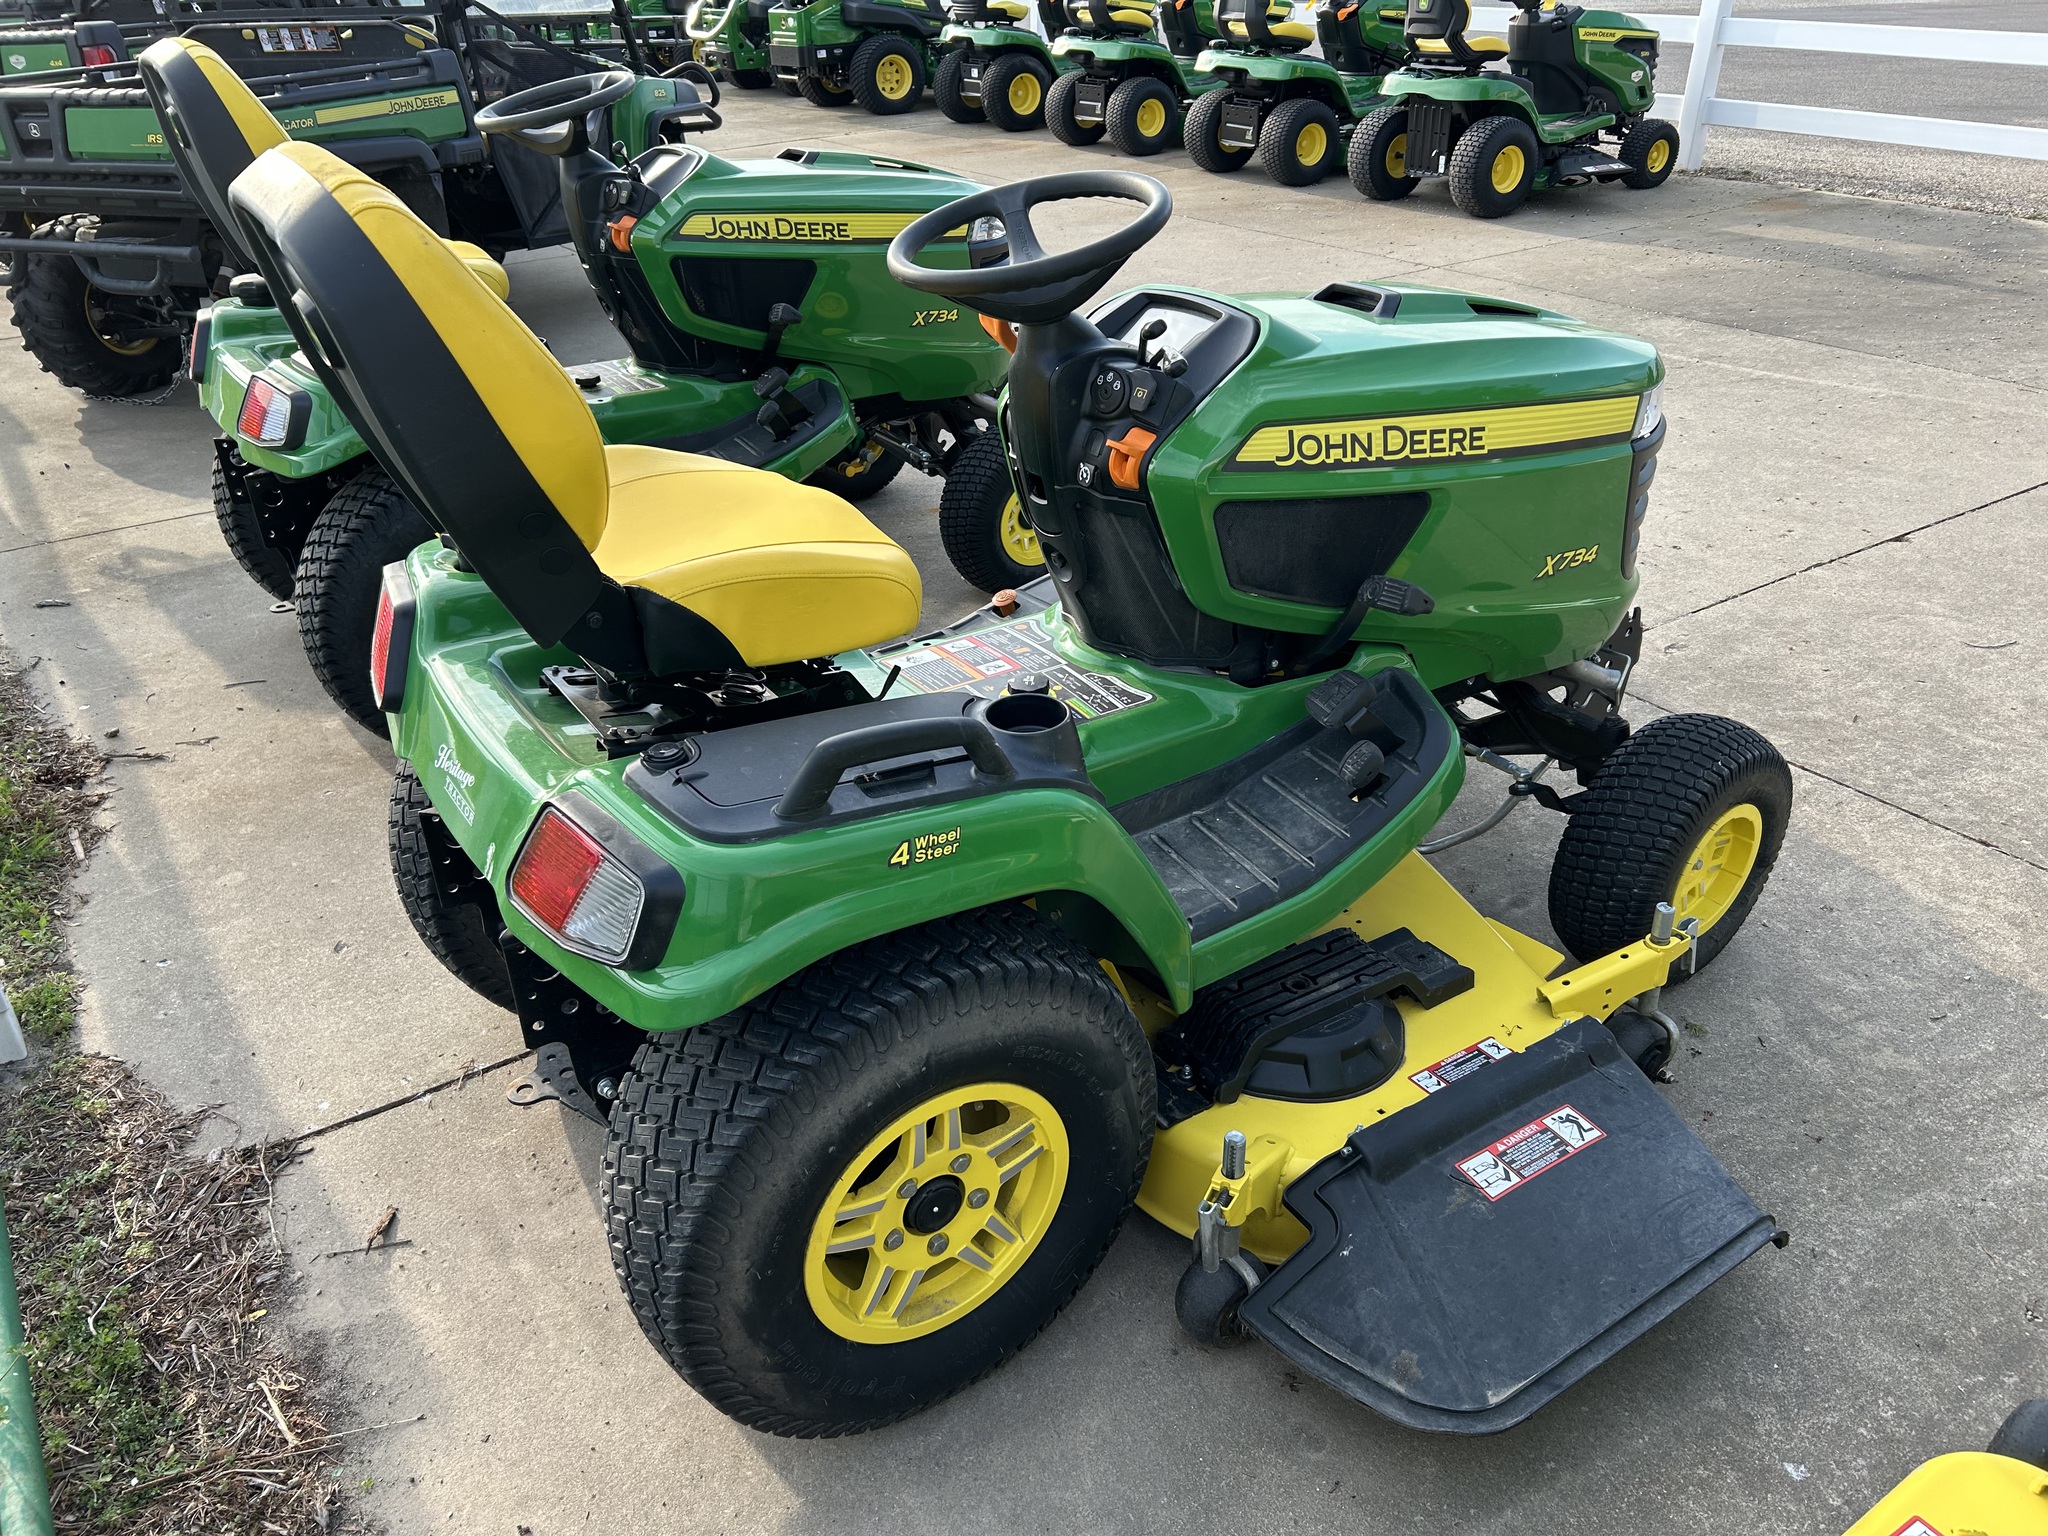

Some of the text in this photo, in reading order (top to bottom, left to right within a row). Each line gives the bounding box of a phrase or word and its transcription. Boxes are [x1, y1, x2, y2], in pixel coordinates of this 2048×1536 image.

[1598, 30, 1617, 38] DEERE
[388, 95, 446, 114] JOHN DEERE
[147, 134, 163, 144] IRS
[705, 216, 852, 239] JOHN DEERE
[911, 308, 959, 327] X734
[1274, 425, 1487, 465] JOHN DEERE
[1535, 544, 1600, 579] X734
[434, 743, 476, 789] Heritage
[444, 776, 476, 825] TRACTOR
[889, 826, 961, 867] 4 Wheel
[914, 842, 960, 864] Steer
[1503, 1123, 1540, 1147] DANGER
